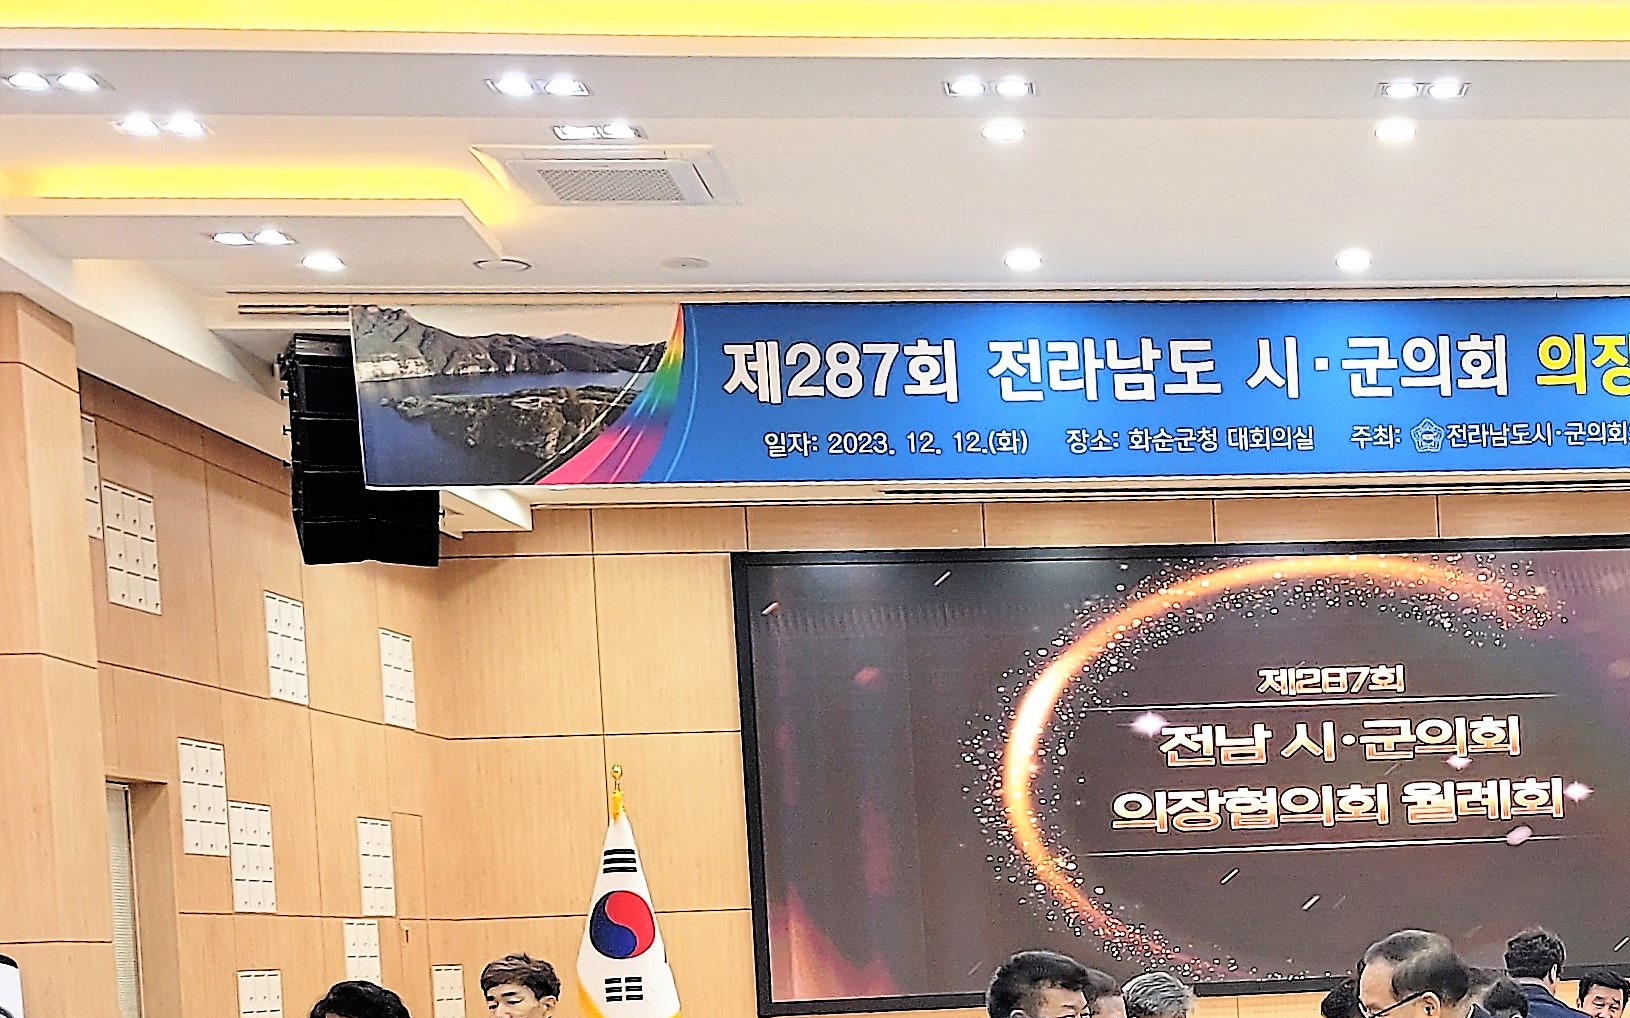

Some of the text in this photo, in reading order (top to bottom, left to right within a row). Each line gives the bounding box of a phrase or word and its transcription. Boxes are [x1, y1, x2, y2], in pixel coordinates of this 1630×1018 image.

[721, 338, 961, 405] 제287회
[988, 335, 1223, 403] 전라남도
[1246, 331, 1510, 400] 시·군의회
[763, 429, 819, 458] 일자:
[827, 429, 895, 457] 2023.
[905, 429, 945, 456] 12.
[953, 427, 1030, 457] 12.(화)
[1065, 426, 1121, 454] 장소:
[1127, 424, 1219, 454] 화순군청
[1226, 422, 1316, 453] 대회의실
[1350, 422, 1402, 450] 주최:
[1257, 663, 1406, 696] 제287회
[1158, 713, 1523, 770] 전남 시·군의회
[1110, 774, 1566, 836] 의장협의회 월례회
